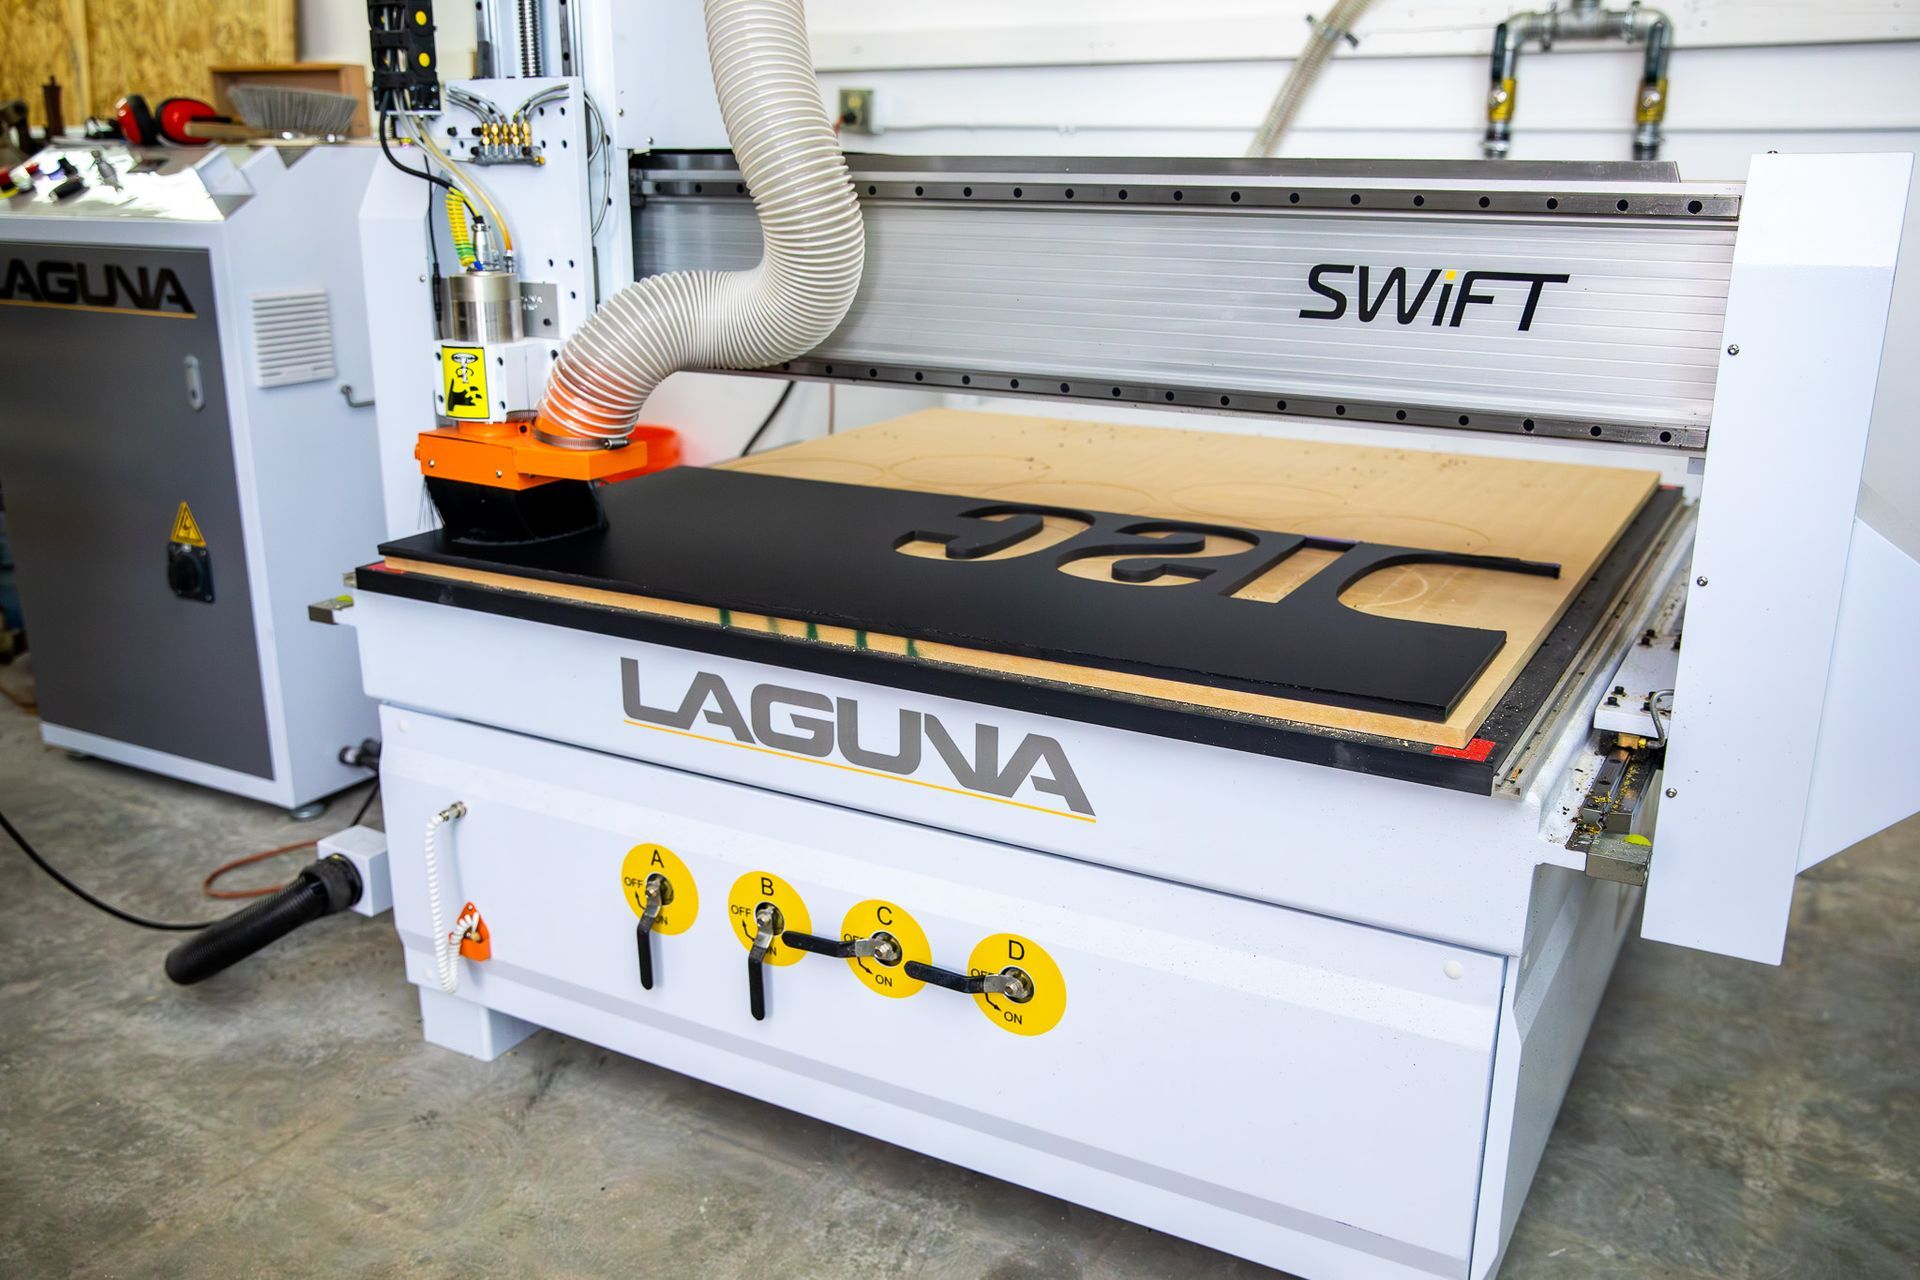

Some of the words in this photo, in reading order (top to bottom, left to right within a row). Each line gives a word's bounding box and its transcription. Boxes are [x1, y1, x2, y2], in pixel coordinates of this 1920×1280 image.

[0, 258, 196, 313] AGUNA
[620, 656, 1096, 816] LAGUNA
[650, 849, 665, 868] A
[624, 876, 643, 888] OFF
[761, 876, 775, 896] B
[730, 904, 752, 917] OFF
[876, 906, 892, 926] C
[1008, 939, 1025, 960] D
[875, 974, 893, 987] ON
[1003, 1011, 1023, 1025] ON
